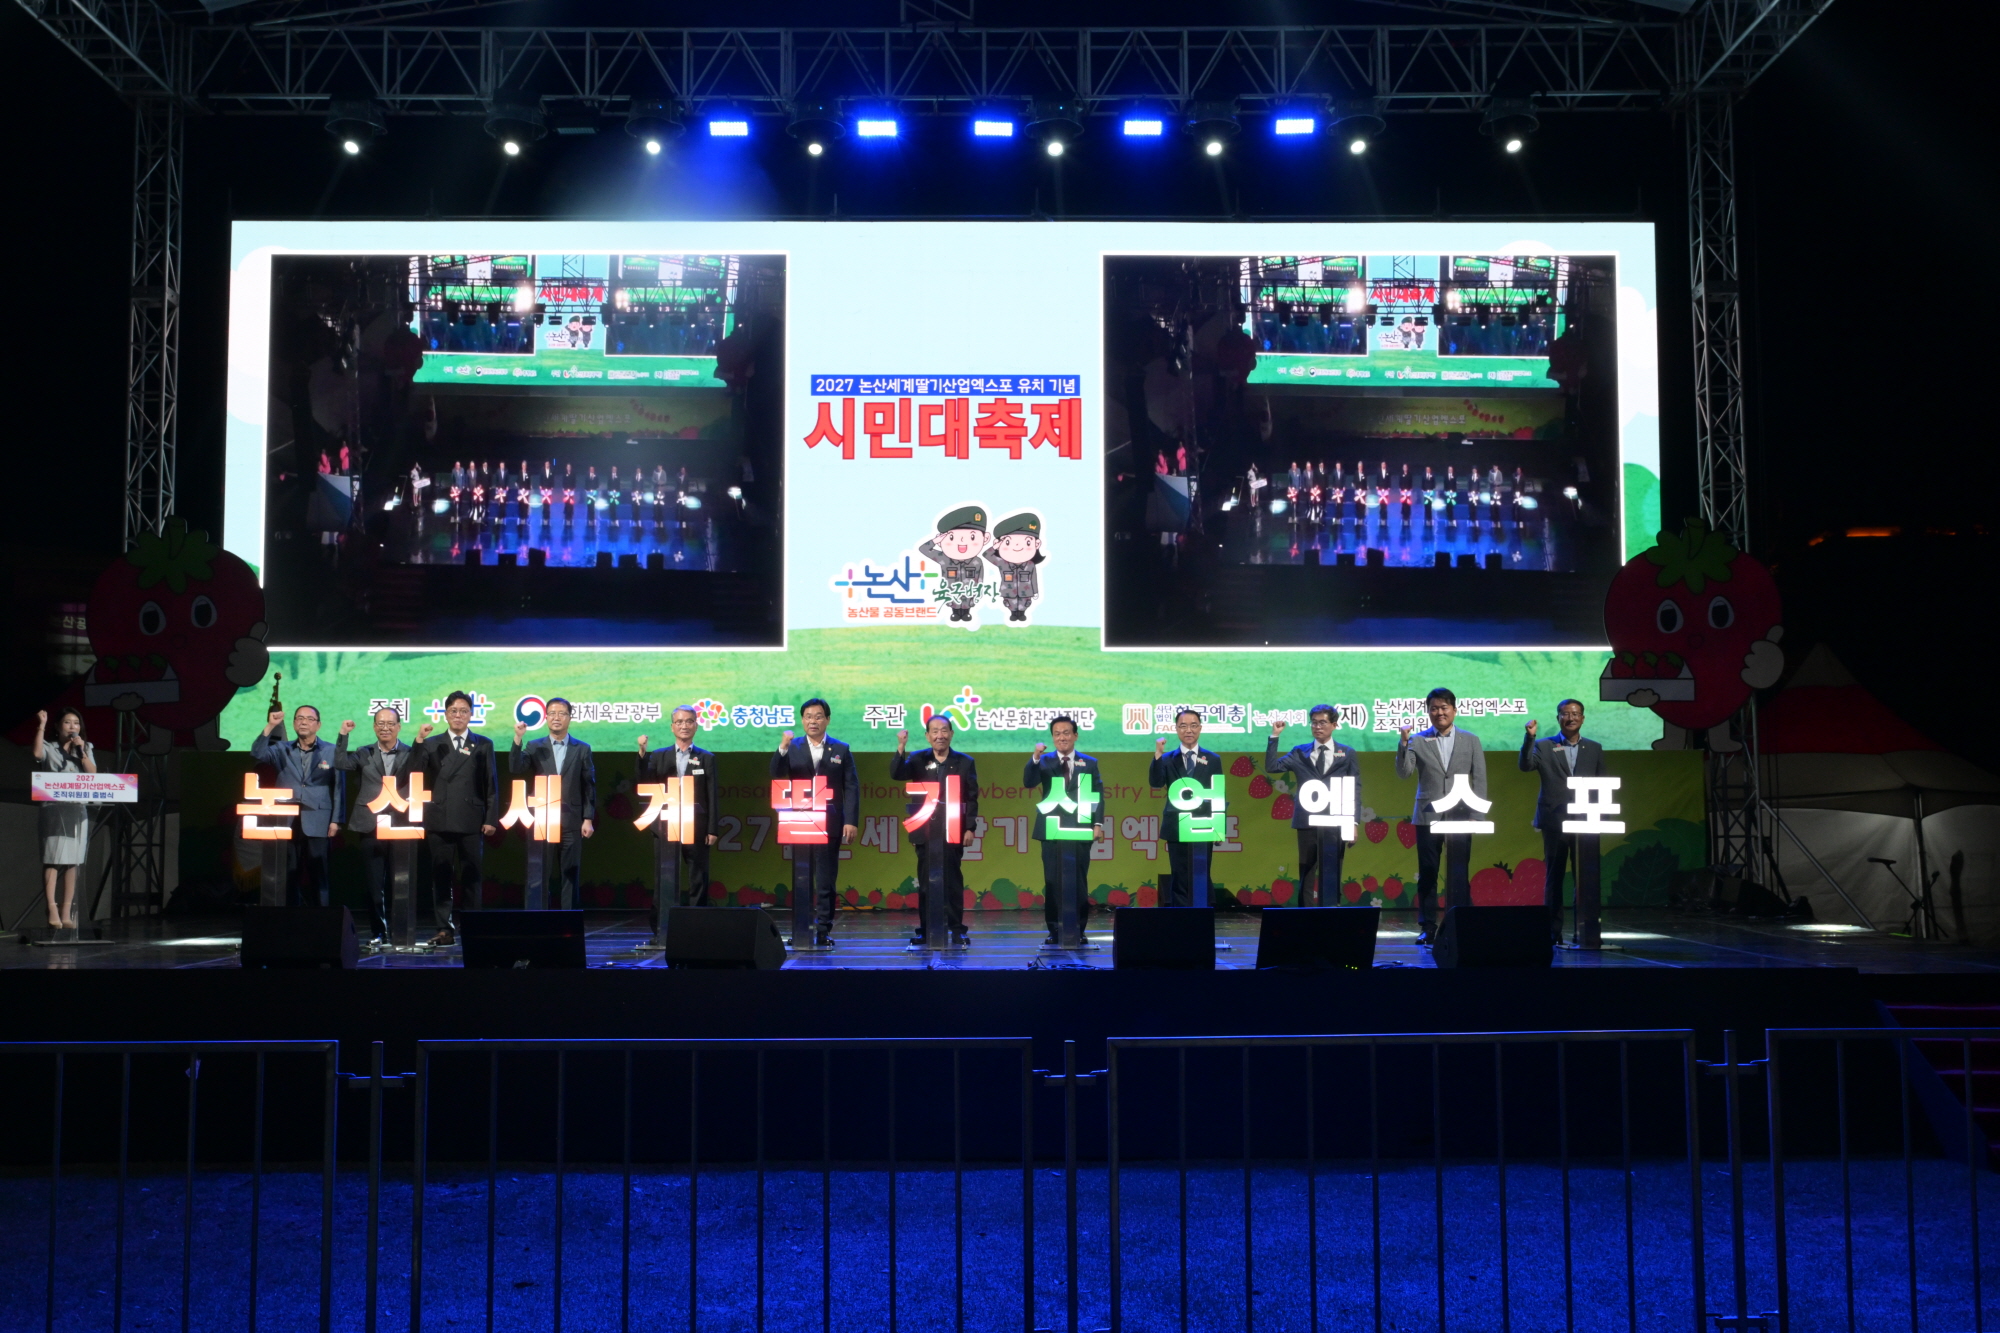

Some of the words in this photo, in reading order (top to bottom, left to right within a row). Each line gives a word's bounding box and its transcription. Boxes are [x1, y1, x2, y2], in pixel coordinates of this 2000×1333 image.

[815, 378, 854, 393] 2027
[858, 378, 1013, 394] 논산세계딸기산업엑스포
[1017, 378, 1045, 394] 유치
[1049, 378, 1076, 394] 기념
[803, 397, 1082, 460] 시민대축제
[851, 555, 926, 604] 논산
[932, 578, 1000, 614] 육군병장
[847, 606, 880, 618] 농산물
[883, 606, 937, 618] 공동브랜드
[570, 704, 660, 721] 화체육관광부
[1156, 705, 1172, 714] 사단
[1374, 700, 1527, 714] 논산세계산업엑스포
[732, 706, 794, 726] 충청남도
[864, 706, 904, 727] 주관
[1156, 714, 1172, 723] 법인
[1253, 710, 1307, 724] 논산지회
[1374, 718, 1430, 732] 조직위원
[75, 774, 95, 782] 2027
[44, 782, 126, 791] 논산세계딸기산업엑스포
[1103, 783, 1143, 803] stry
[53, 791, 90, 799] 조직위원회
[92, 791, 114, 799] 출범식
[236, 772, 300, 839] 논
[366, 771, 432, 840] 산
[499, 774, 562, 843] 세
[633, 774, 694, 844] 계
[770, 775, 834, 844] 딸
[902, 774, 961, 844] 기
[1036, 773, 1100, 841] 산
[1168, 774, 1226, 842] 업
[1299, 776, 1355, 841] 엑
[1430, 773, 1494, 834] 스
[1562, 776, 1626, 834] 포
[717, 815, 772, 852] 27
